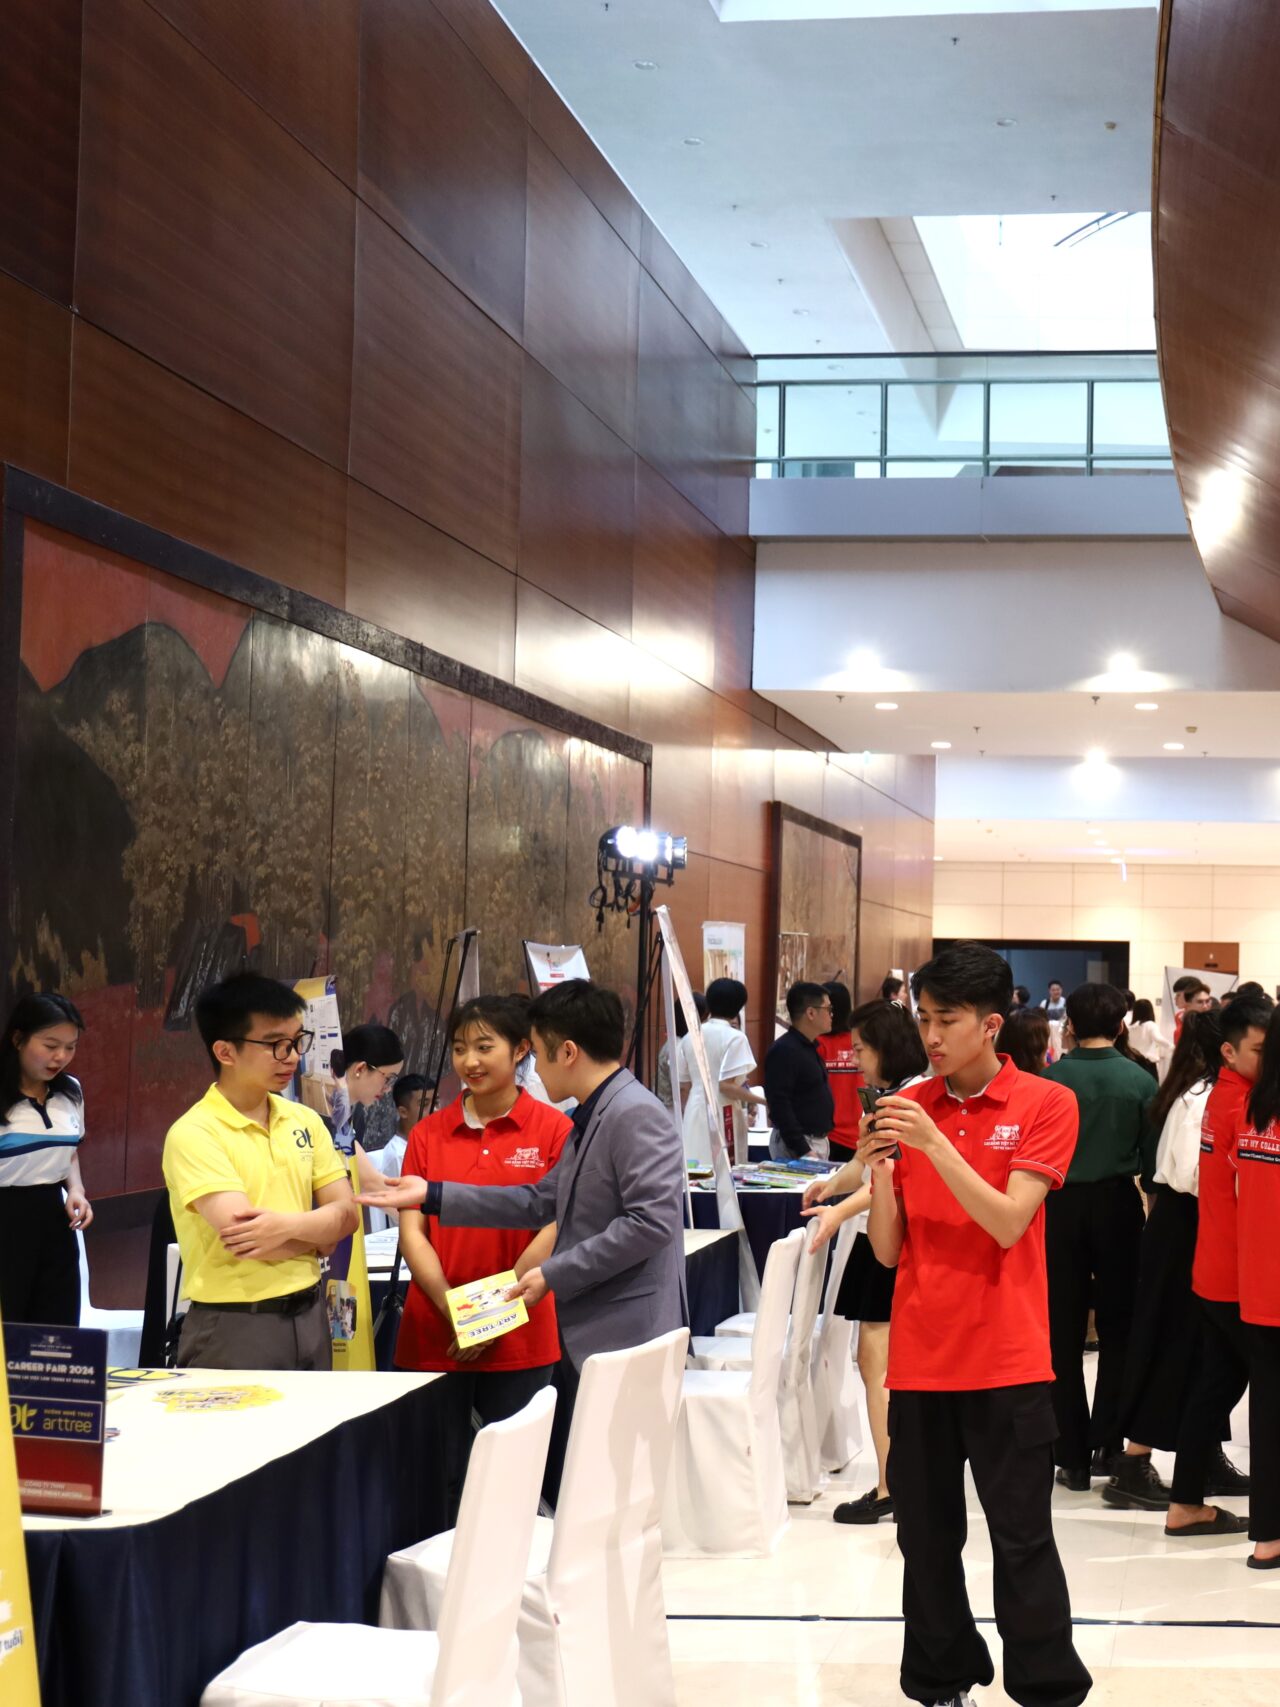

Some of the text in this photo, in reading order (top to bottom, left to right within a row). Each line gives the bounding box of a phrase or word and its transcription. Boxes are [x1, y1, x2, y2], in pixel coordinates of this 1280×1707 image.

[7, 1361, 94, 1376] CAREER FAIR 2024
[43, 1417, 92, 1433] arttree
